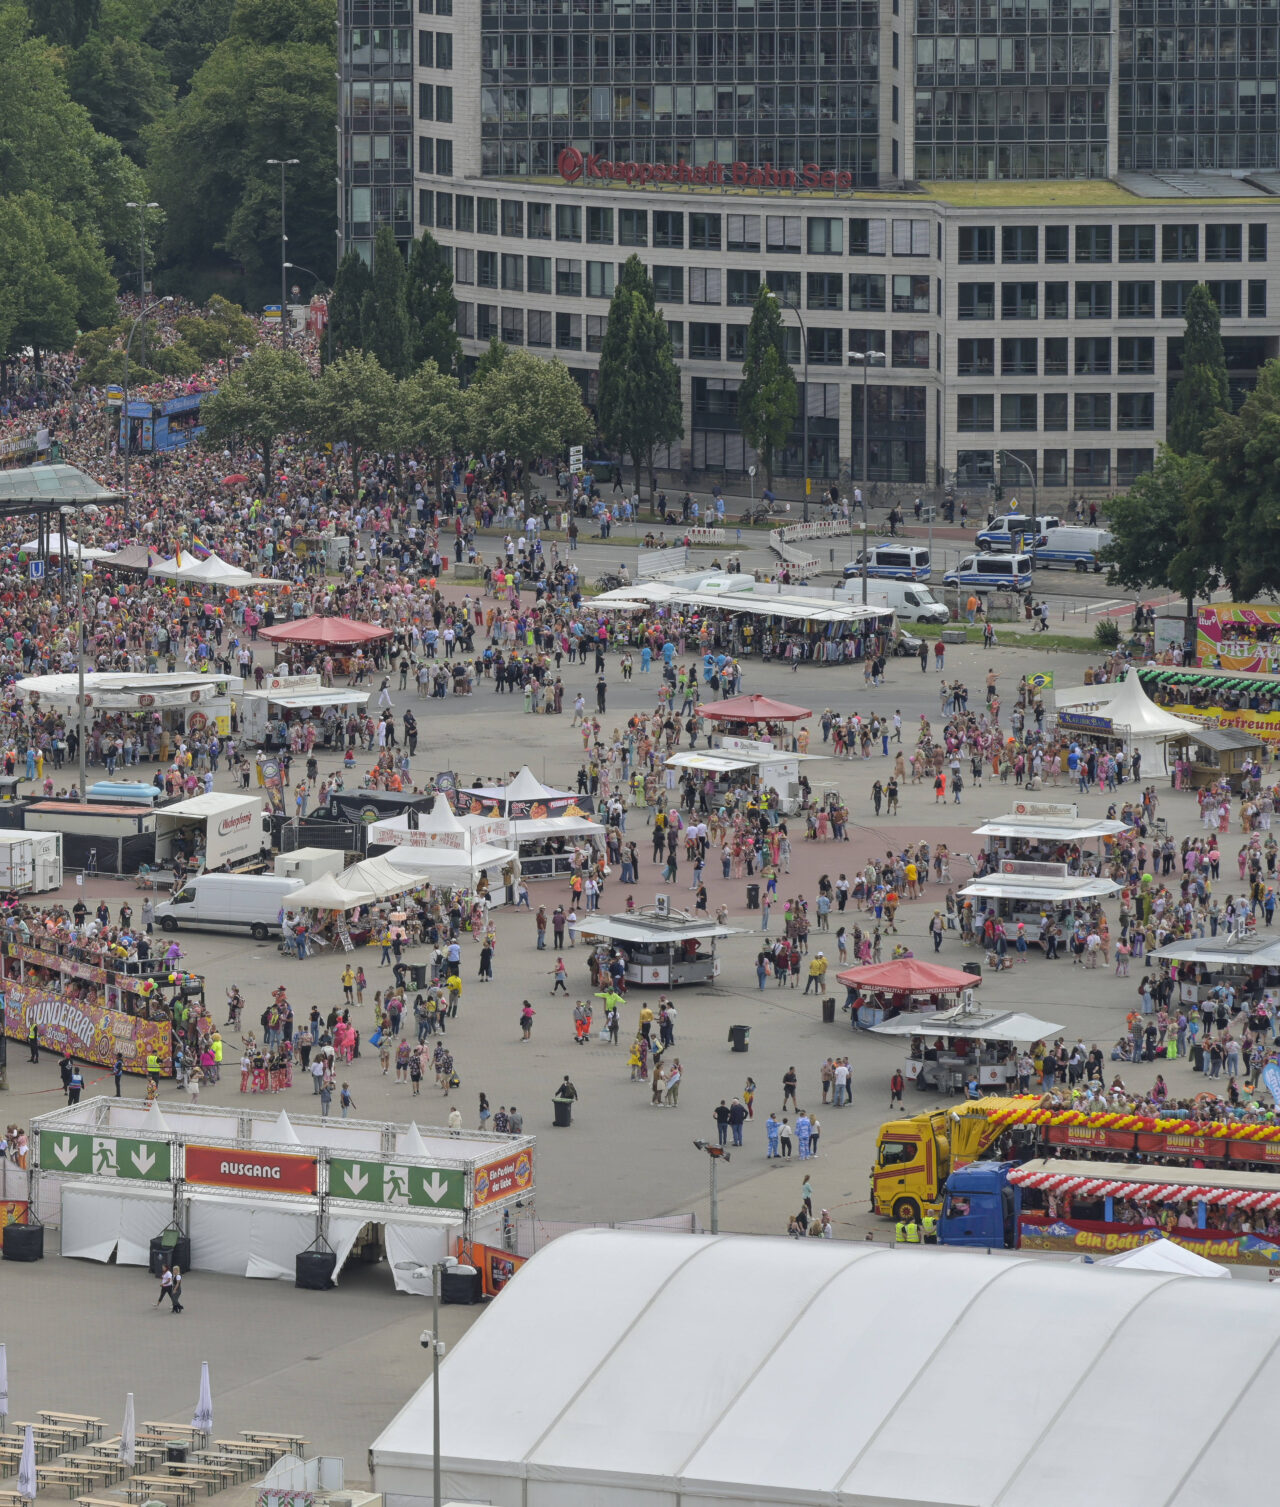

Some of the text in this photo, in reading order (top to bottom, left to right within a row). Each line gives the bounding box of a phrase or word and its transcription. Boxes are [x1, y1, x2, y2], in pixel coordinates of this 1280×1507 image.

[587, 154, 852, 187] Knappschaft Bahn See
[32, 562, 42, 576] U
[26, 1001, 95, 1048] WUNDERBAR
[114, 1040, 136, 1056] MUSIC
[1068, 1127, 1106, 1140] BUDDY'S
[1166, 1134, 1205, 1148] BUDDY'S
[220, 1161, 281, 1179] AUSGANG
[489, 1162, 515, 1180] Ein Festival
[1075, 1230, 1102, 1248] Ein
[1105, 1233, 1138, 1249] Bett
